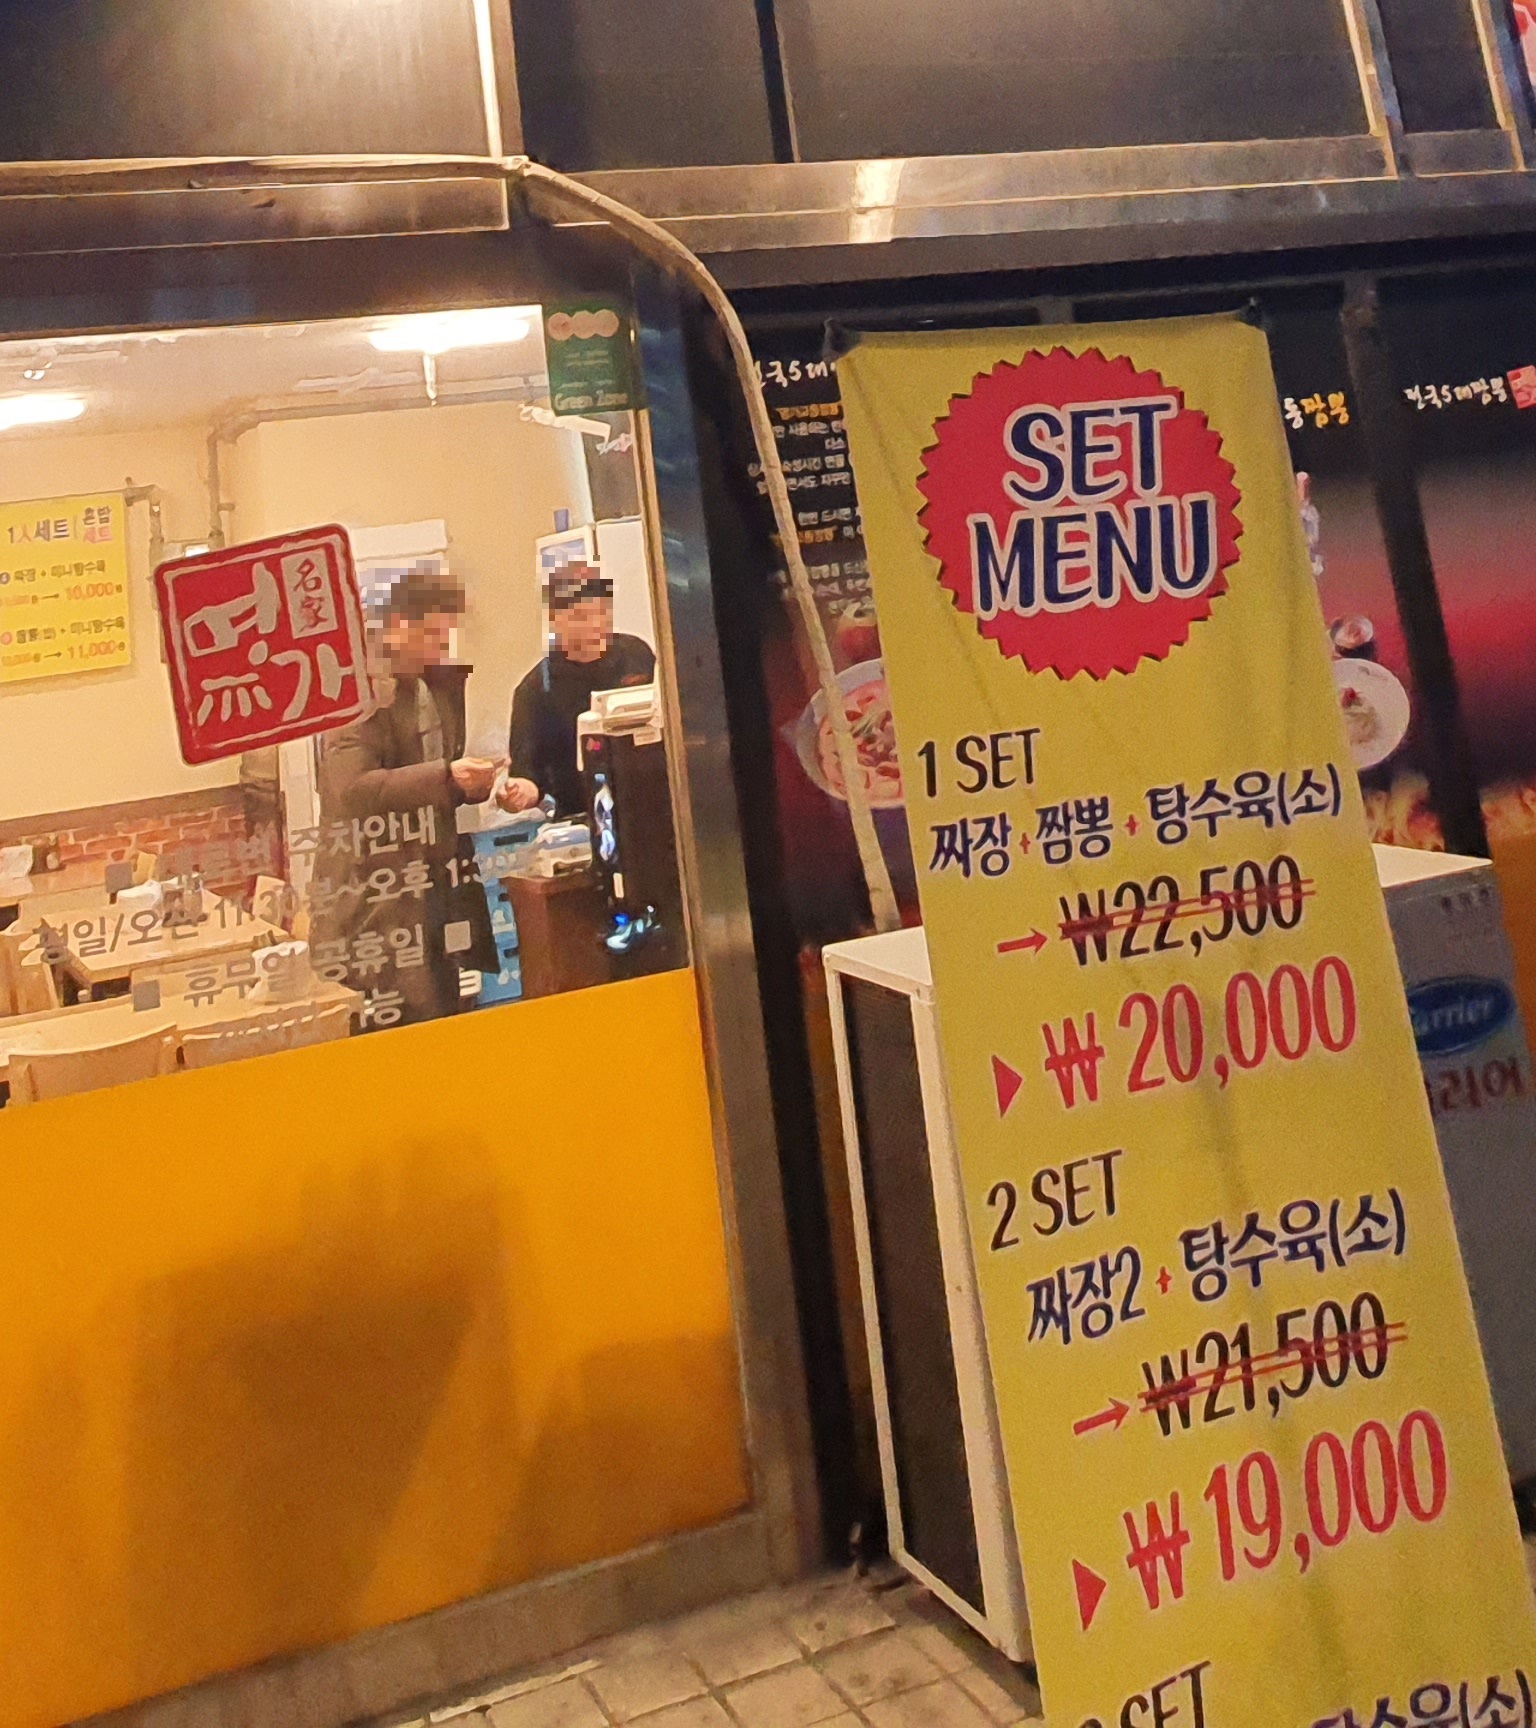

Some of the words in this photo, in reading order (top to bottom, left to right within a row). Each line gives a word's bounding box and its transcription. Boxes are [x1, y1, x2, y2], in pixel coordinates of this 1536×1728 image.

[1004, 397, 1178, 506] SET
[1284, 391, 1350, 429] 동짬뽕
[970, 495, 1216, 616] MENU
[917, 742, 938, 799] 1
[957, 728, 1041, 794] SET
[290, 805, 436, 860] 주차안내
[929, 811, 1013, 879] 짜장
[1034, 796, 1113, 867] 짬뽕
[1145, 762, 1343, 845] 탕수육(소)
[1425, 1056, 1527, 1111] 리어
[986, 1180, 1018, 1252] 2
[1031, 1149, 1123, 1237] SET
[1179, 1187, 1408, 1303] 탕수육(소)
[1312, 1668, 1534, 1728] 수육(소)
